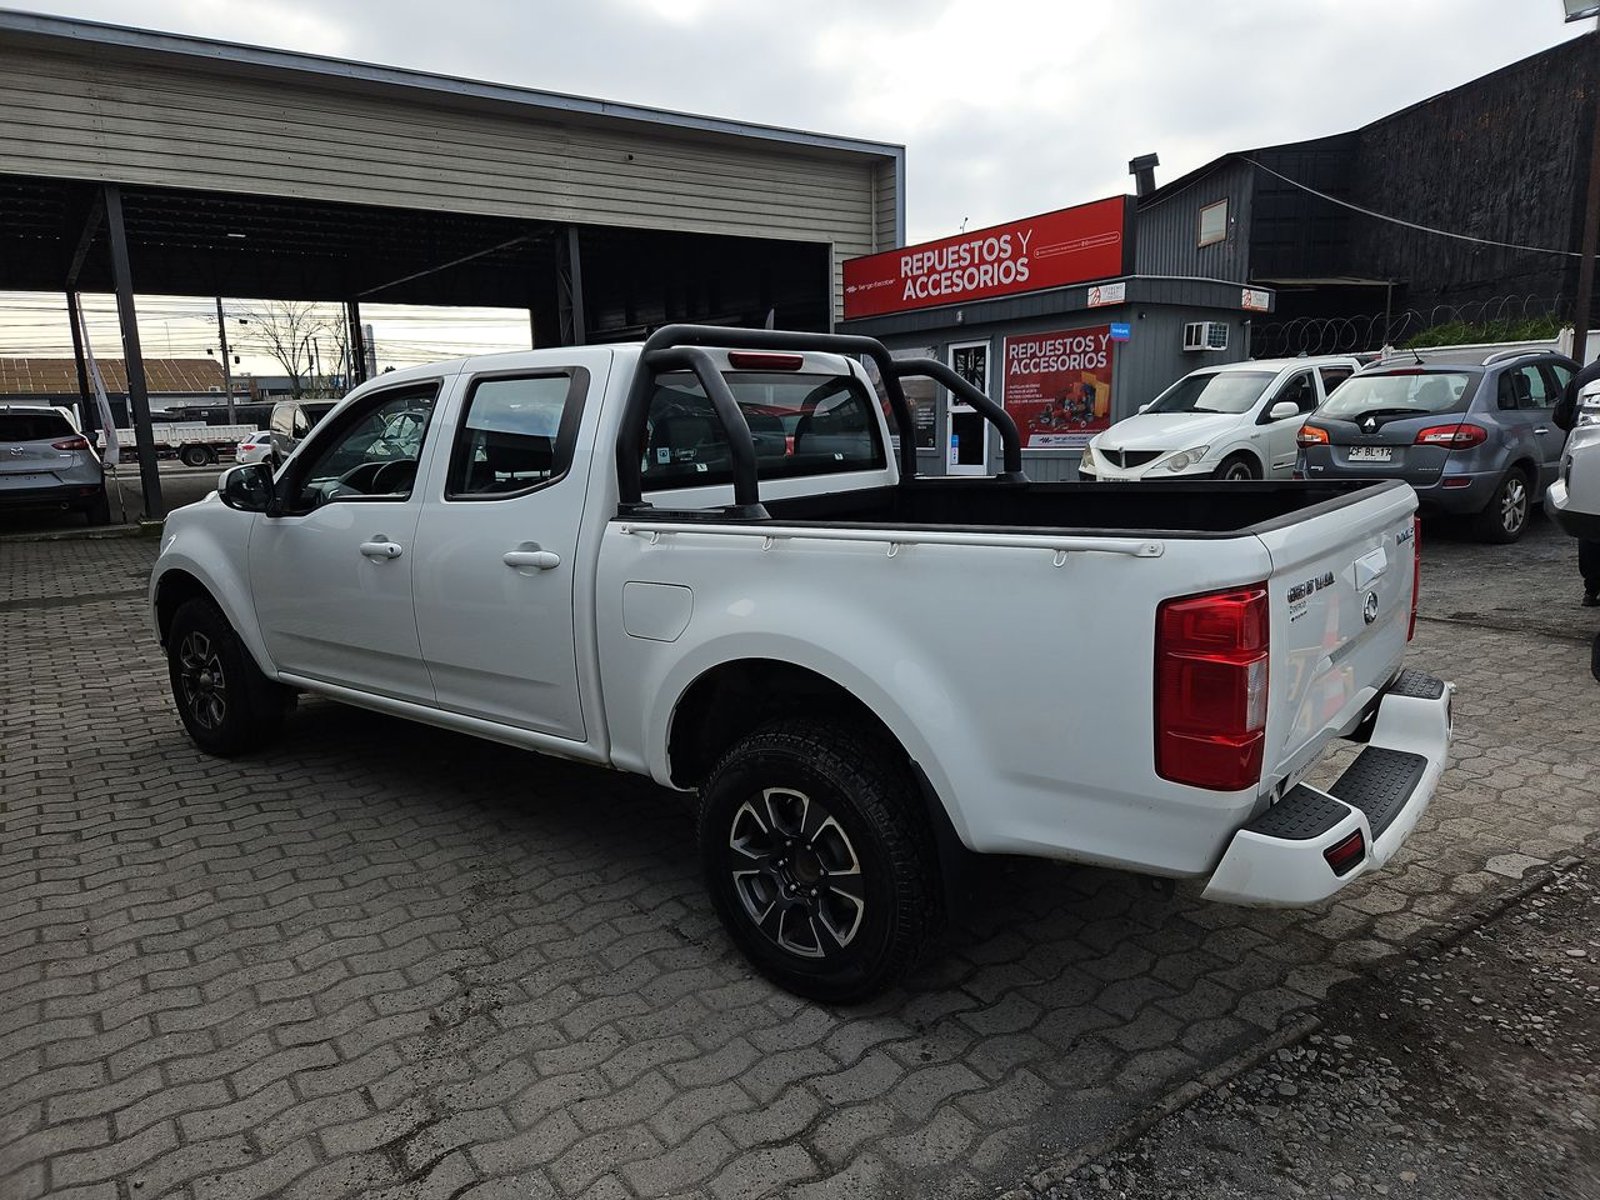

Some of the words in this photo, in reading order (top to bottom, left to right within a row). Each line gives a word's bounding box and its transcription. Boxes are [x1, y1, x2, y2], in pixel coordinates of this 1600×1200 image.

[901, 234, 1012, 278] REPUESTOS
[1017, 229, 1032, 254] Y
[903, 257, 1029, 300] ACCESORIOS
[1009, 335, 1095, 359] REPUESTOS
[1099, 333, 1110, 350] Y
[1010, 352, 1107, 375] ACCESORIOS
